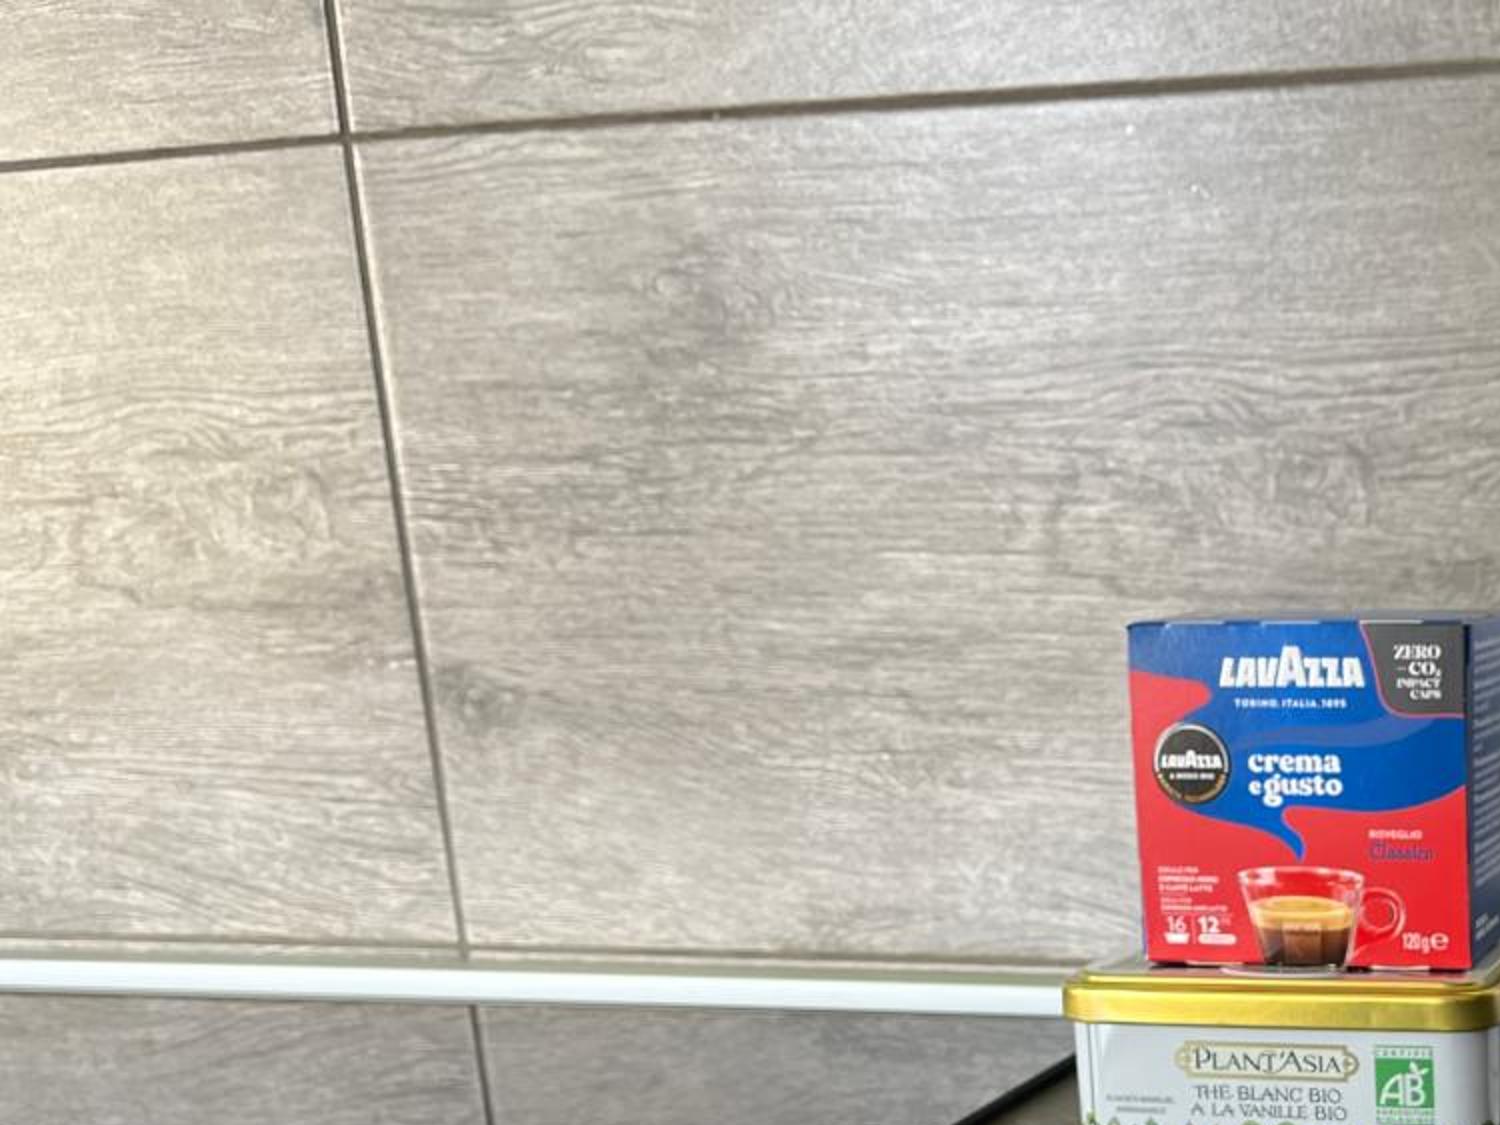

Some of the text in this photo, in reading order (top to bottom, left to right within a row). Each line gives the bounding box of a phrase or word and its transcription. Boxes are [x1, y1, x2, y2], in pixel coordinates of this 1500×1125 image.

[1393, 644, 1441, 659] ZERO
[1219, 645, 1365, 688] LAVAZZA
[1161, 749, 1223, 768] LAVAZZA
[1248, 753, 1341, 773] crema
[1249, 774, 1343, 807] e gusto
[1167, 915, 1222, 934] 16 12
[1193, 1046, 1342, 1074] PLANT'ASIA
[1238, 1085, 1304, 1104] BLANC
[1308, 1088, 1342, 1105] BIO
[1380, 1072, 1427, 1107] AB
[1211, 1102, 1235, 1118] LA
[1238, 1103, 1308, 1120] VANILLE
[1315, 1105, 1349, 1122] BIO
